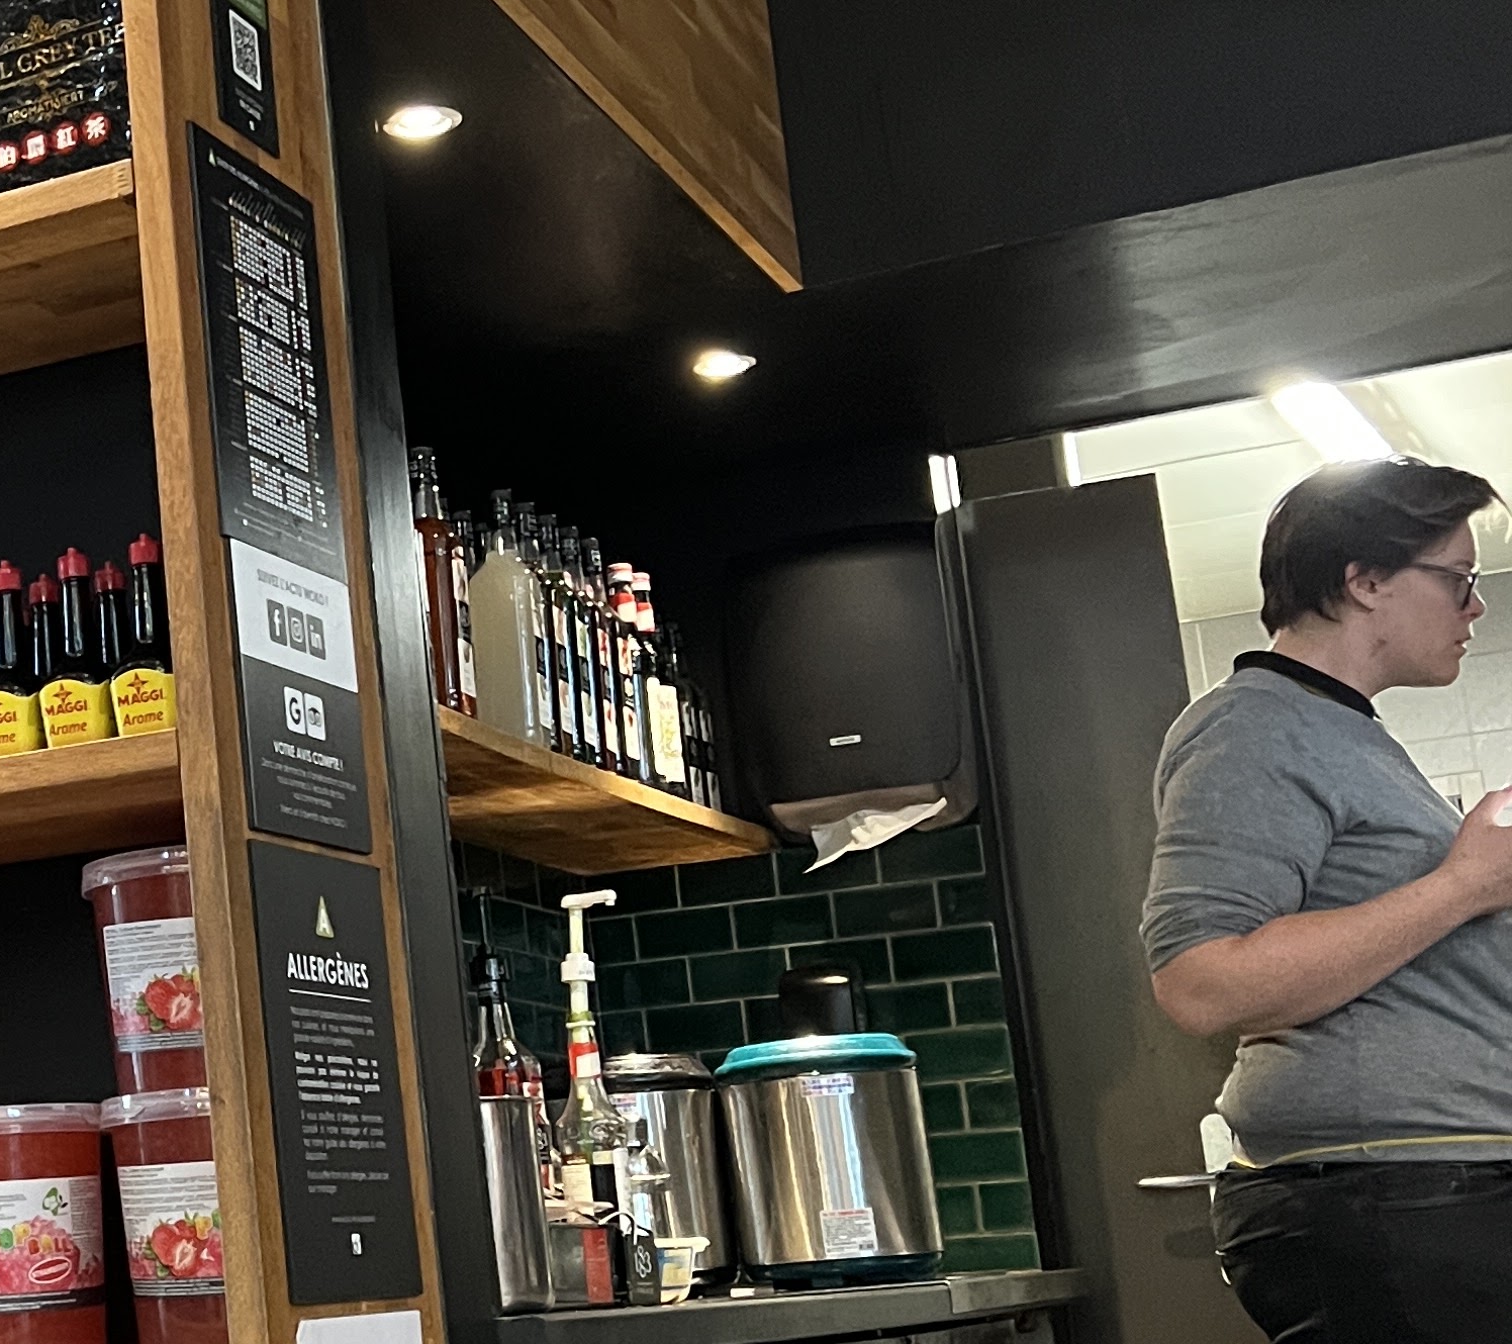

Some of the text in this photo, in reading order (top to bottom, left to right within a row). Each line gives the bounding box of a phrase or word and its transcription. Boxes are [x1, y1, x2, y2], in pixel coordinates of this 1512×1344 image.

[17, 36, 78, 73] GREY
[118, 688, 166, 707] MAGGI
[45, 700, 88, 716] MAGGI
[123, 711, 164, 727] Arome
[49, 721, 87, 736] Arome
[287, 951, 369, 989] ALLERGÈNES
